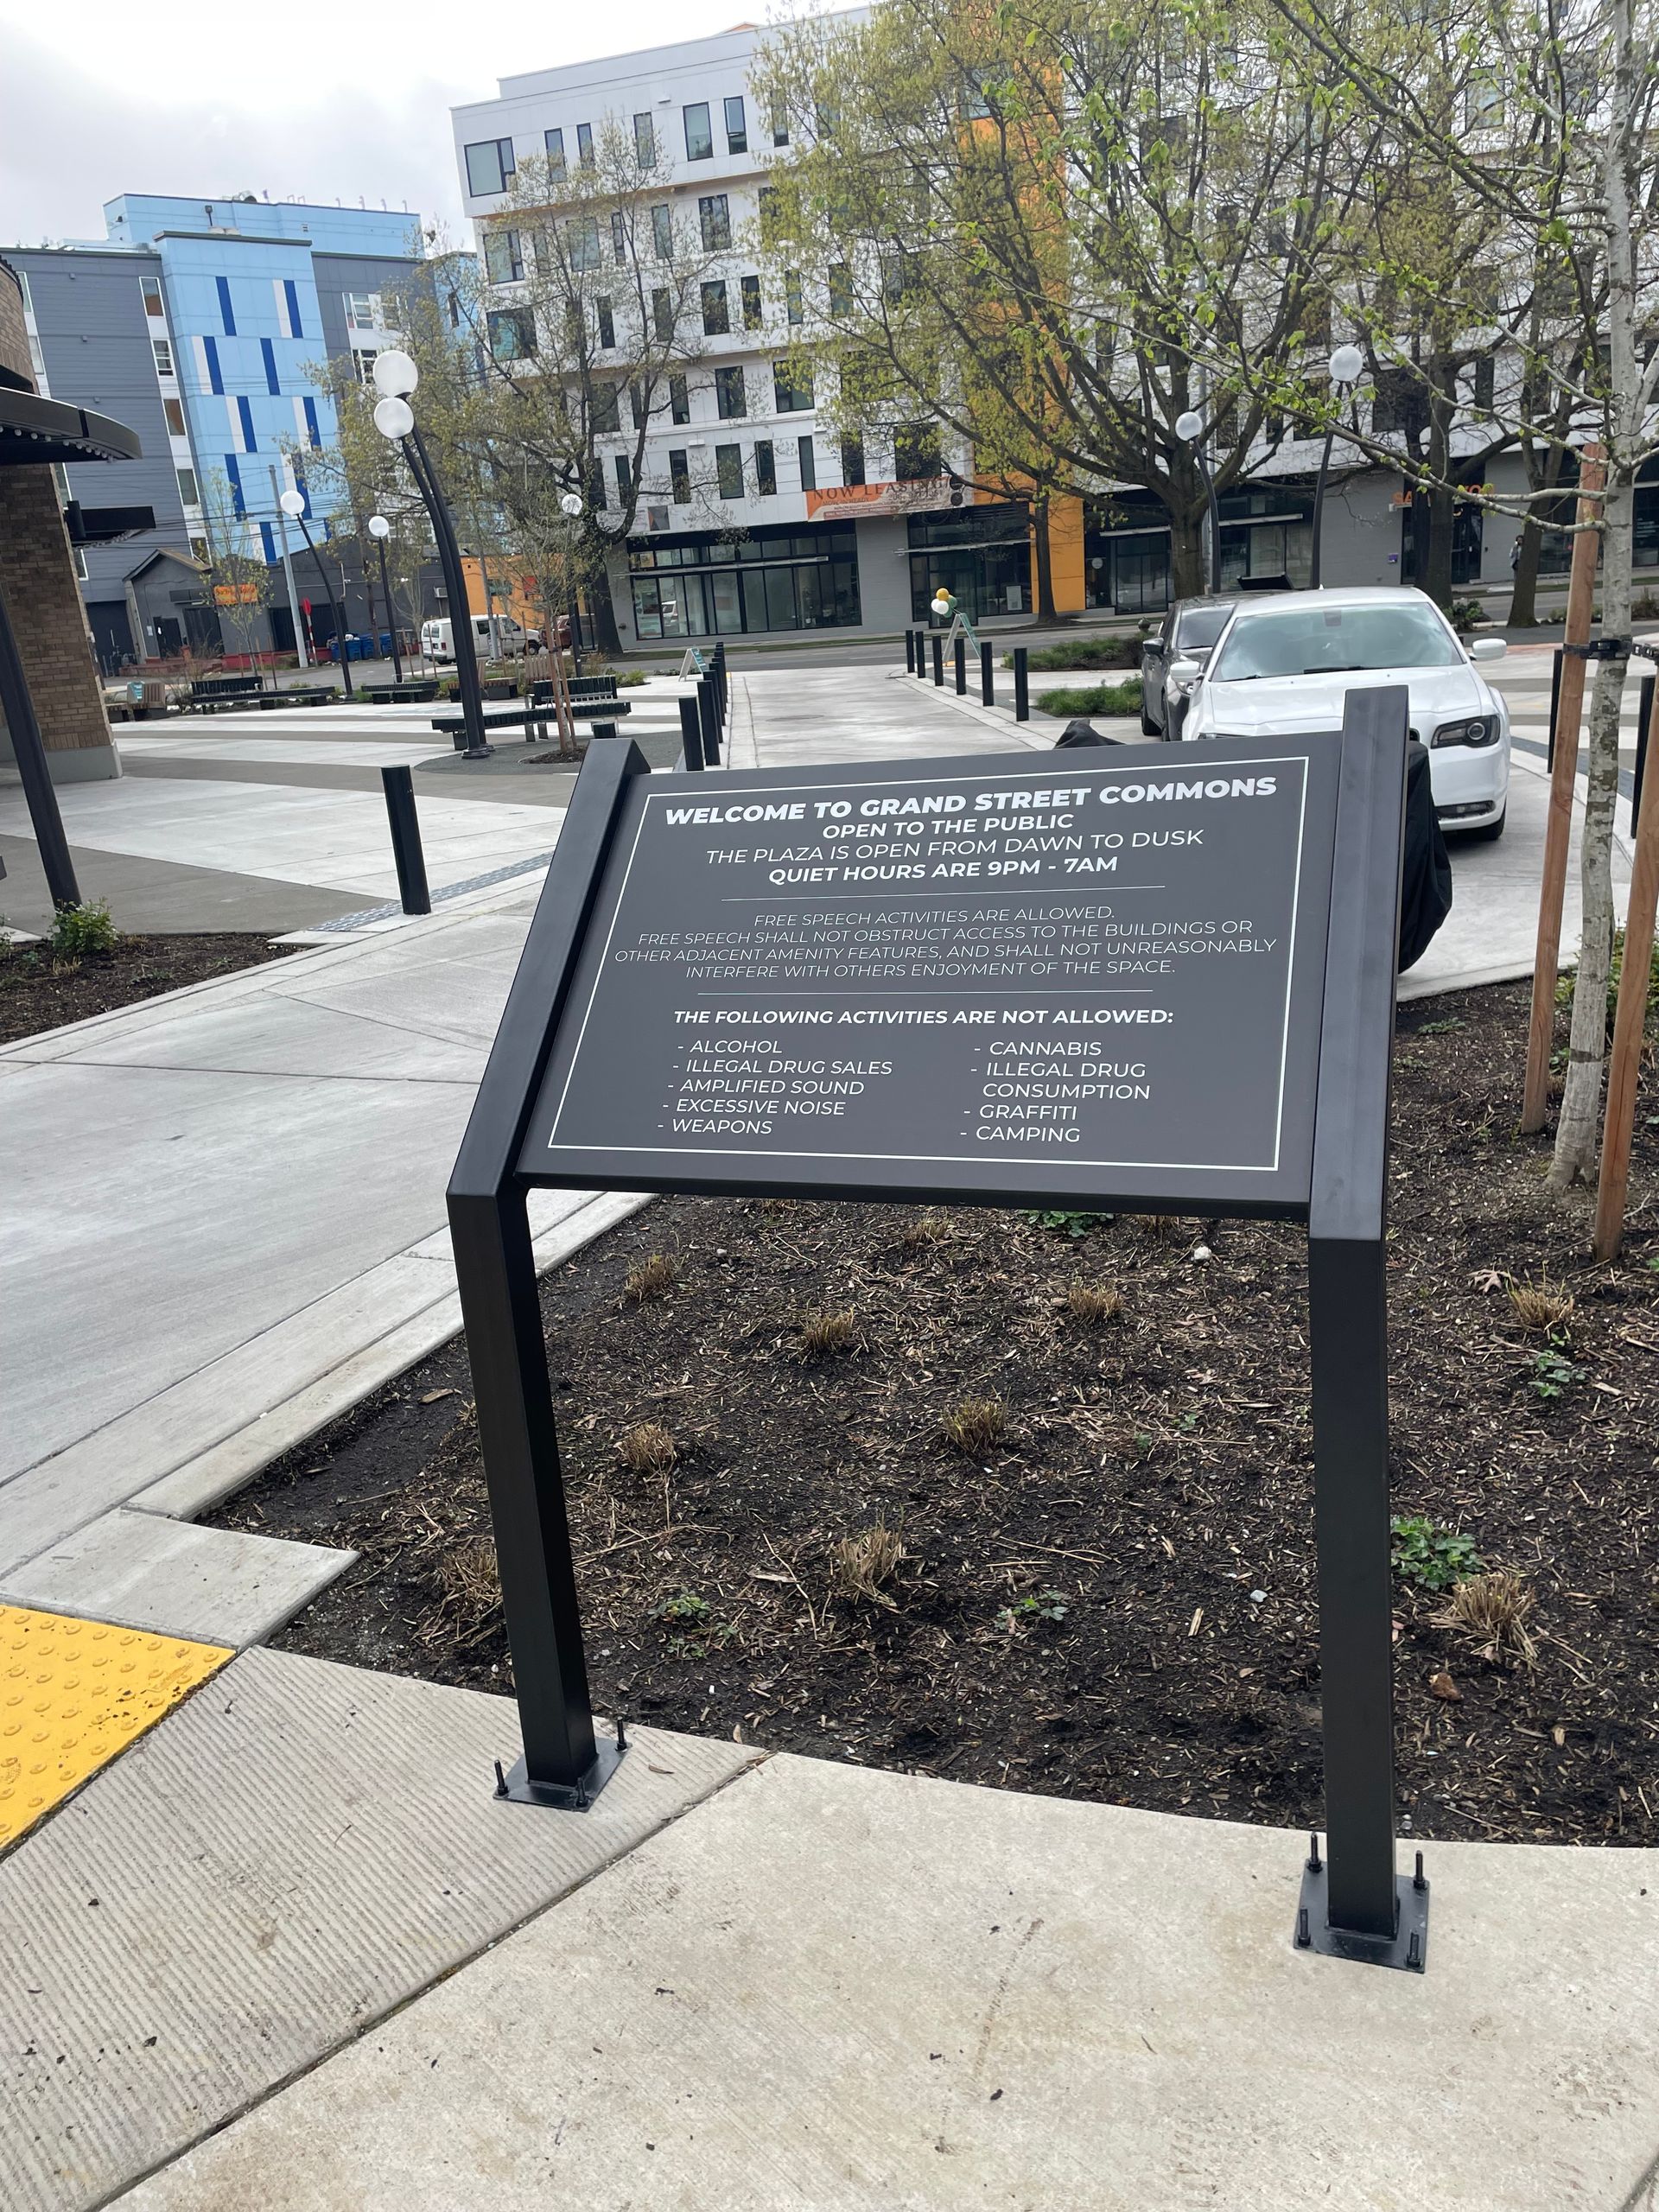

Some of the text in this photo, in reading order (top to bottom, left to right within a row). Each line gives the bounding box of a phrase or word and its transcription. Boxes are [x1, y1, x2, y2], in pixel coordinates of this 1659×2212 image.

[814, 486, 855, 500] NOW
[665, 777, 1277, 825] WELCOME TO GRAND STREET COMMONS
[823, 813, 1075, 839] OPEN TO THE PUBLIC
[706, 829, 1204, 864] THE PLAZA IS OPEN FROM DAWN TO DUSK
[768, 867, 839, 886] QUIET
[842, 863, 926, 881] HOURS
[931, 861, 982, 878] ARE
[987, 859, 1041, 876] 9PM
[1064, 856, 1118, 873] 7AM
[754, 906, 1115, 926] FREE SPEECH ACTIVITIES ARE ALLOWED.
[639, 920, 1253, 945] FREE SPEECH SHALL NOT OBSTRUCT ACCESS TO THE BUILDINGS OR
[614, 938, 1277, 962] OTHER ADJACENT AMENITY FEATURES, AND SHALL NOT UNREASONABLY
[686, 960, 1175, 978] INTERFERE WITH OTHERS ENJOYMENT OF THE SPACE.
[674, 1009, 1173, 1024] THE FOLLOWING ACTIVITIES ARE NOT ALLOWED:
[690, 1039, 783, 1053] ALCOHOL
[989, 1041, 1102, 1056] CANNABIS
[686, 1059, 763, 1073] ILLEGAL
[767, 1060, 826, 1074] DRUG
[830, 1060, 893, 1075] SALES
[987, 1062, 1074, 1077] ILLEGAL
[1080, 1063, 1146, 1077] DRUG
[679, 1078, 786, 1093] AMPLIFIED
[790, 1080, 865, 1095] SOUND
[982, 1083, 1150, 1100] CONSUMPTION
[676, 1098, 779, 1114] EXCESSIVE
[784, 1100, 846, 1116] NOISE
[979, 1104, 1077, 1121] GRAFFITI
[672, 1118, 772, 1135] WEAPONS
[976, 1126, 1080, 1142] CAMPING
